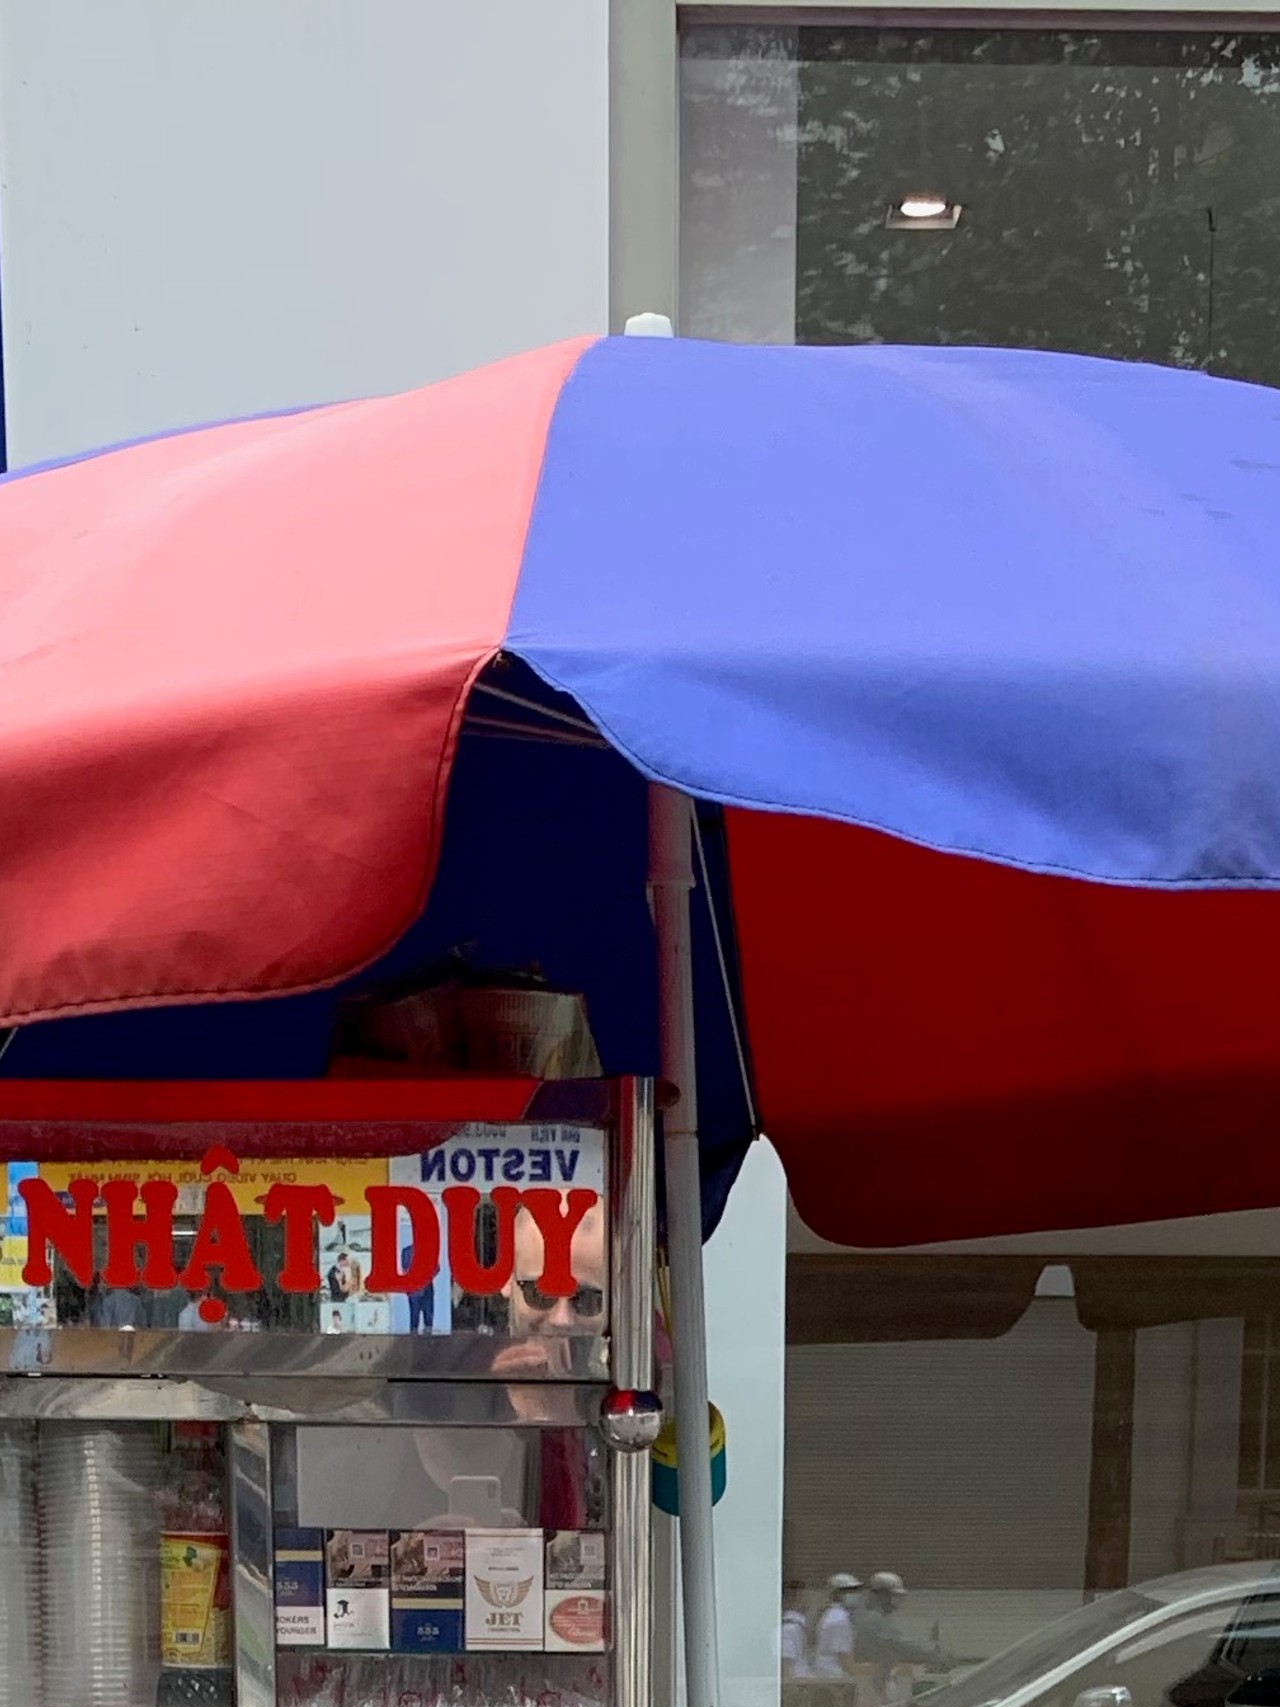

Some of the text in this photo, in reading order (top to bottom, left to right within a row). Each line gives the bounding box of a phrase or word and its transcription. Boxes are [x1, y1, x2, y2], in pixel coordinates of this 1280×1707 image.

[17, 1143, 336, 1324] NHẬT
[364, 1185, 598, 1299] DUY
[485, 1612, 523, 1626] JET
